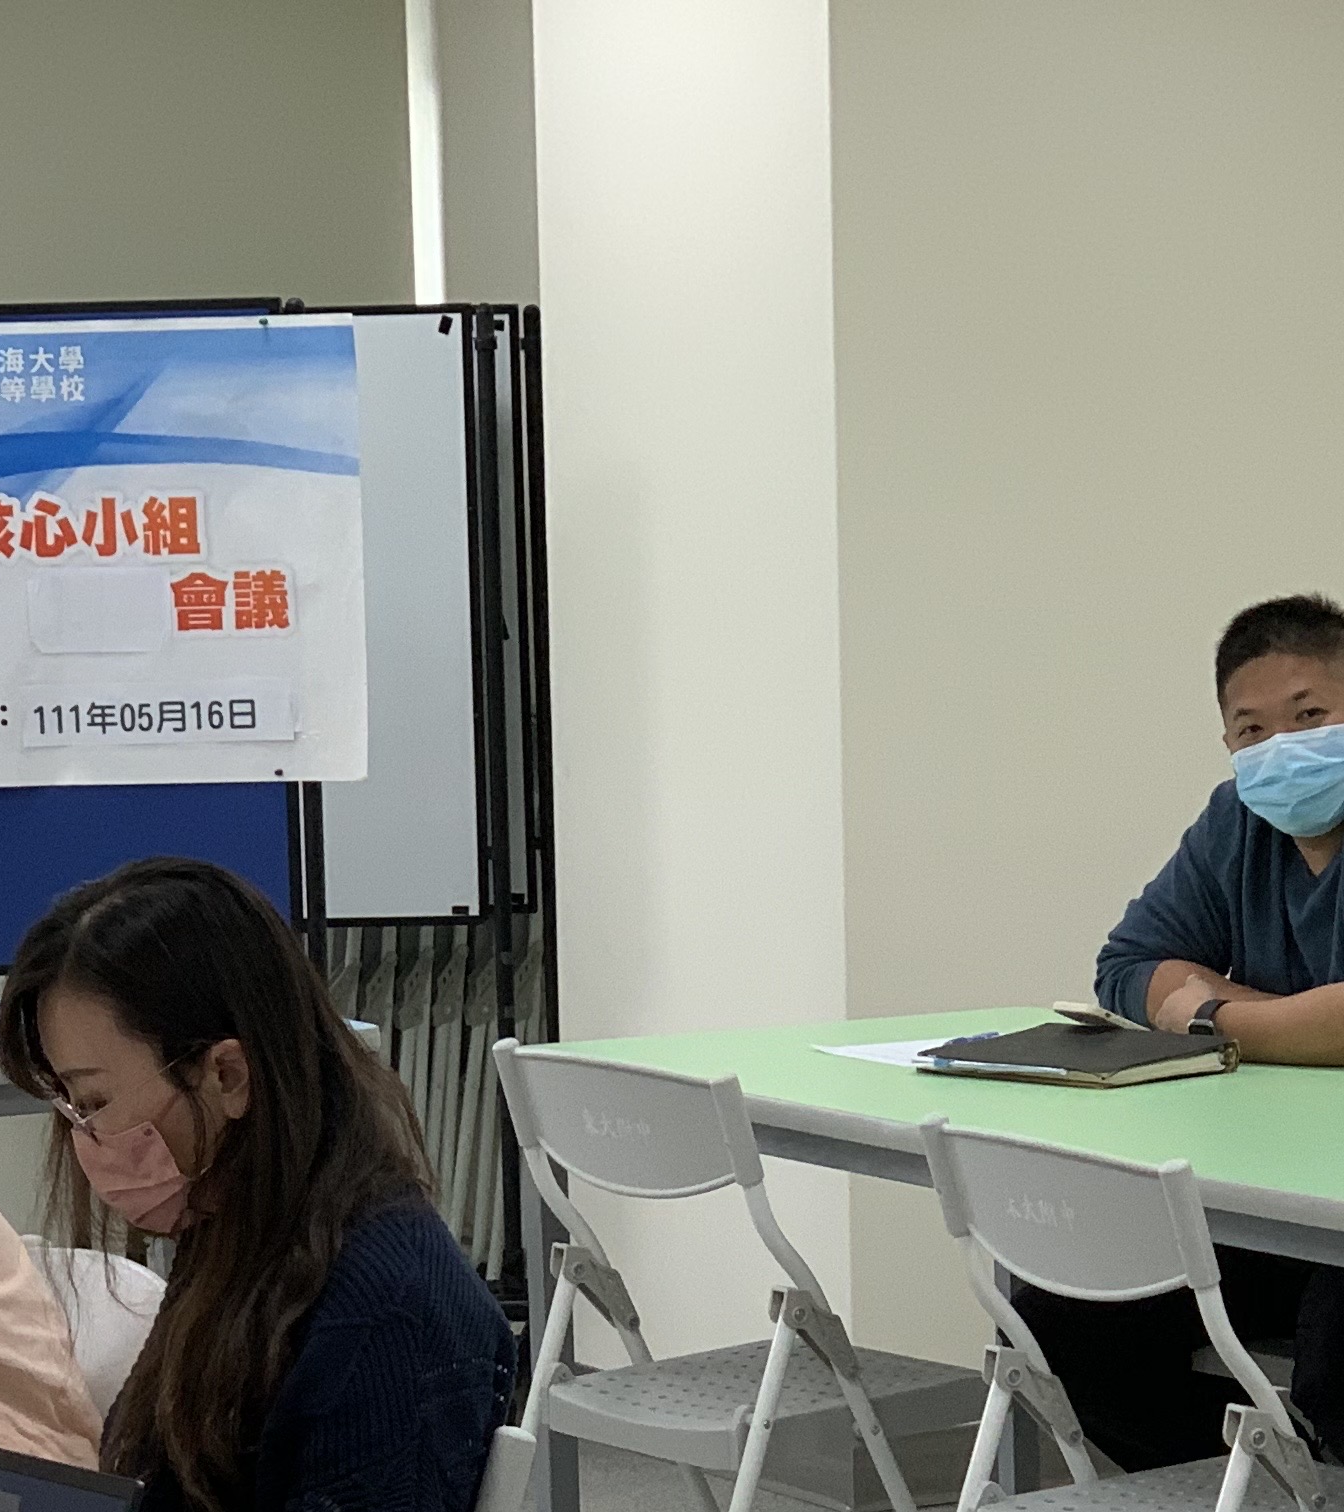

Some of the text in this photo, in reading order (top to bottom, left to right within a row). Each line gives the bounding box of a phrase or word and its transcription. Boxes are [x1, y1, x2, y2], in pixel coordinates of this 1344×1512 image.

[170, 569, 291, 632] 會議
[33, 699, 257, 734] 111年05月16日
